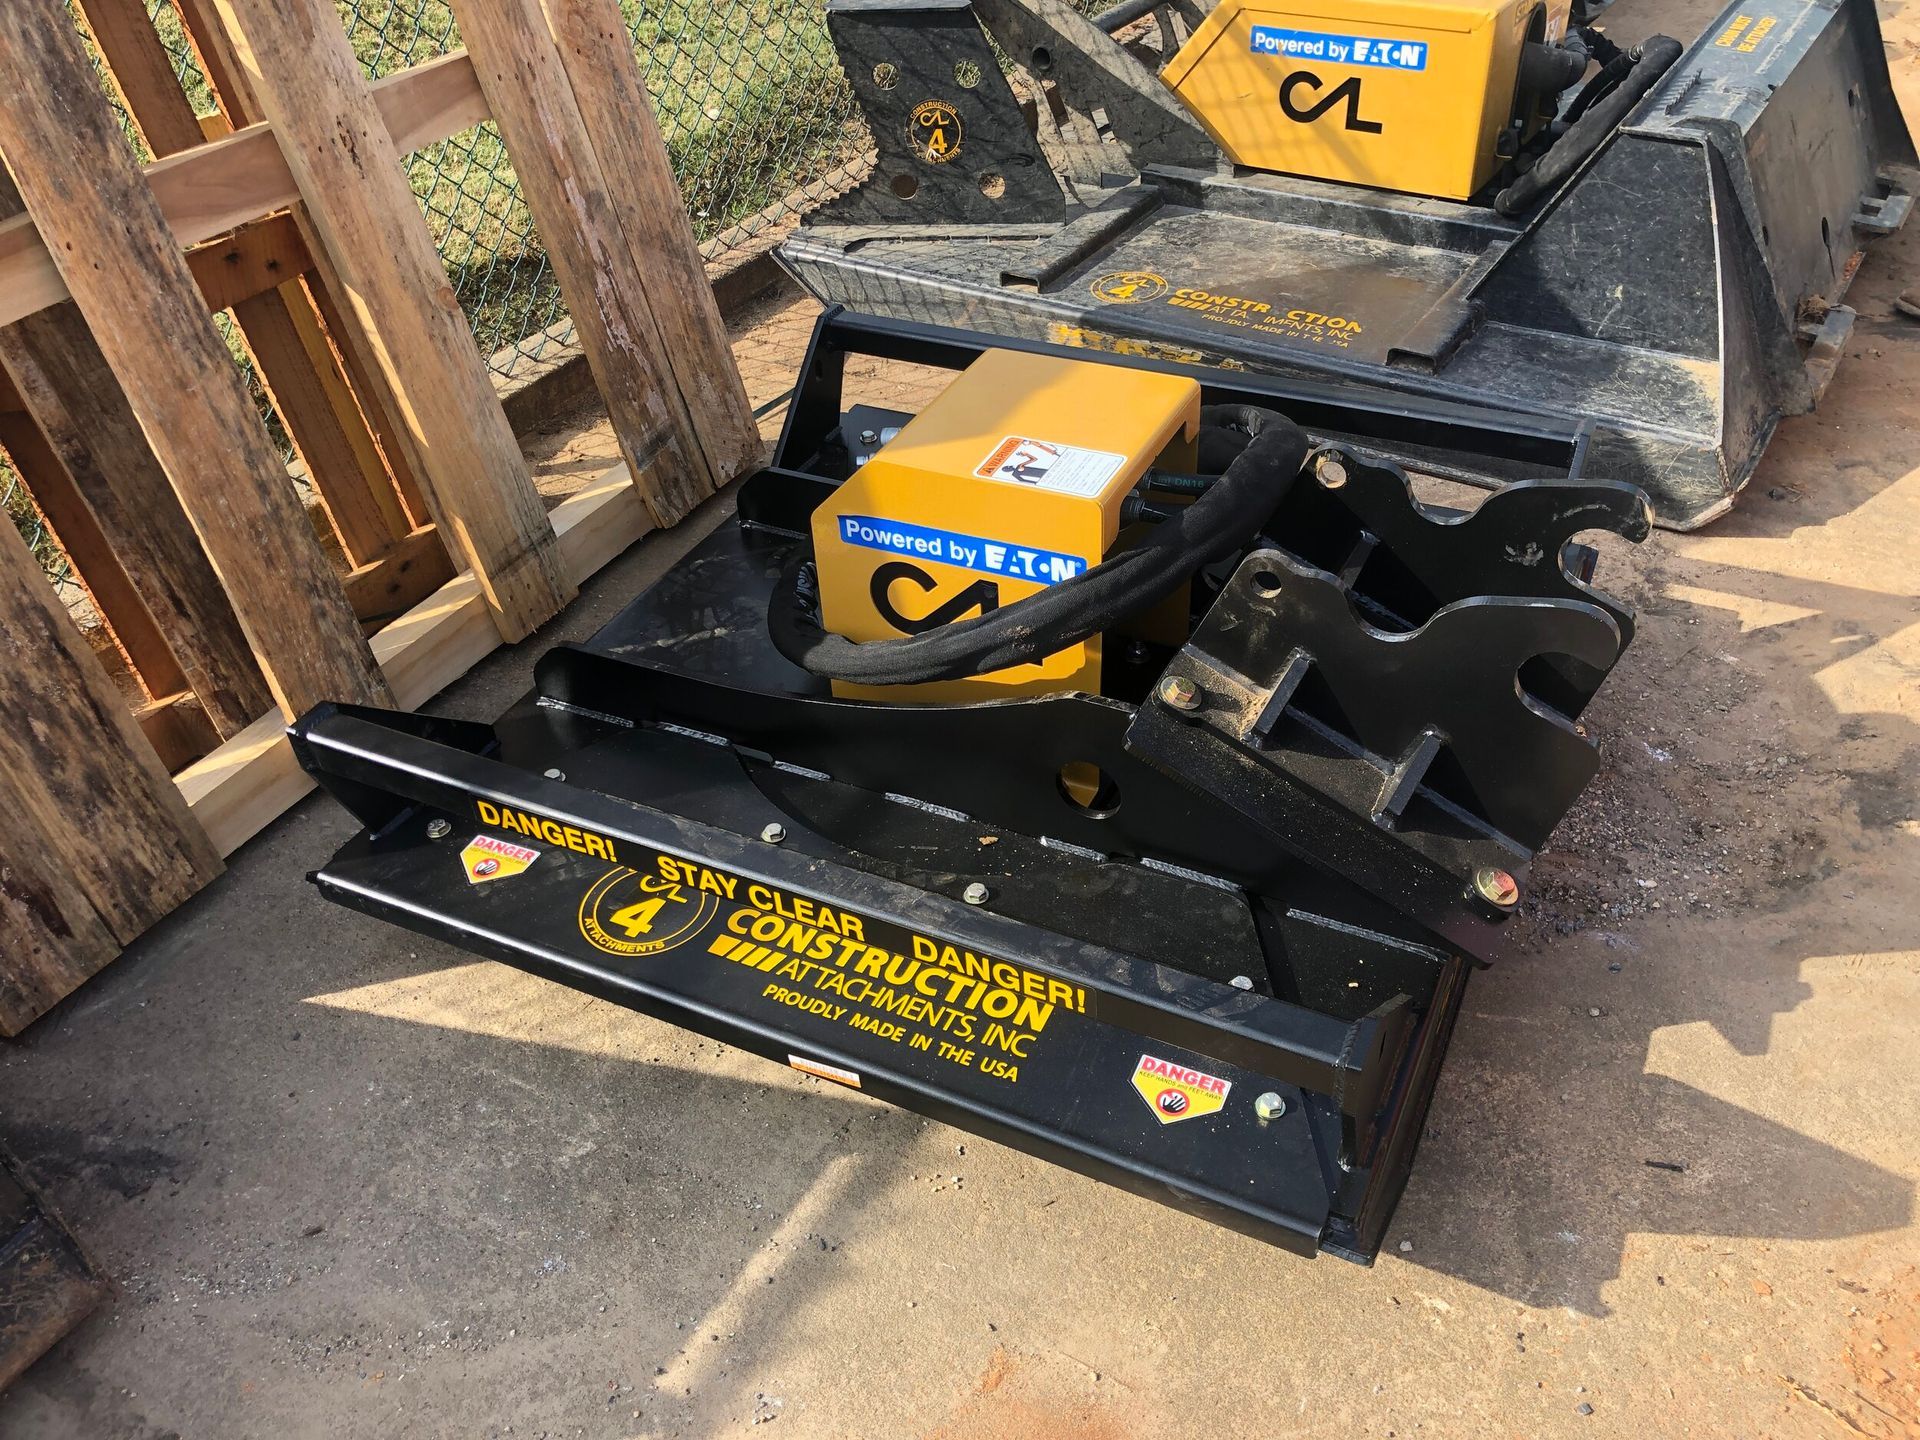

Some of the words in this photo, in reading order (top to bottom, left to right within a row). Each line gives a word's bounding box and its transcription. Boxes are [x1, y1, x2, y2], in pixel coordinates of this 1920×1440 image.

[1255, 32, 1324, 56] Powered
[1329, 41, 1349, 62] by
[1353, 40, 1420, 67] EATON
[910, 101, 958, 119] CONSTRUCTION
[929, 128, 948, 154] 4
[1175, 288, 1362, 333] CONSTRCTION
[1251, 323, 1285, 335] MADE
[1326, 329, 1354, 341] INC
[990, 440, 1020, 469] WARNING
[845, 518, 943, 556] Powered
[950, 540, 978, 567] by
[985, 544, 1076, 582] EATON
[473, 836, 536, 862] DANGER
[477, 800, 618, 863] DANGER!
[657, 856, 738, 900] STAY
[748, 885, 866, 942] CLEAR
[912, 934, 1086, 1014] DANGER!
[609, 897, 667, 938] 4
[584, 918, 665, 952] ATTACHMENTS
[726, 908, 1055, 1033] CONSTRUCTION
[776, 958, 978, 1044] ATTACHMENTS,
[980, 1023, 1038, 1058] INC
[762, 984, 848, 1025] PROUDLY
[849, 1012, 907, 1042] MADE
[909, 1032, 935, 1052] IN
[938, 1042, 976, 1067] THE
[980, 1056, 1018, 1084] USA
[1139, 1070, 1154, 1079] KEEP
[1156, 1076, 1176, 1086] HANDS
[1188, 1087, 1204, 1095] FEET
[1205, 1092, 1222, 1101] AWAY
[1142, 1057, 1226, 1094] DANGER
